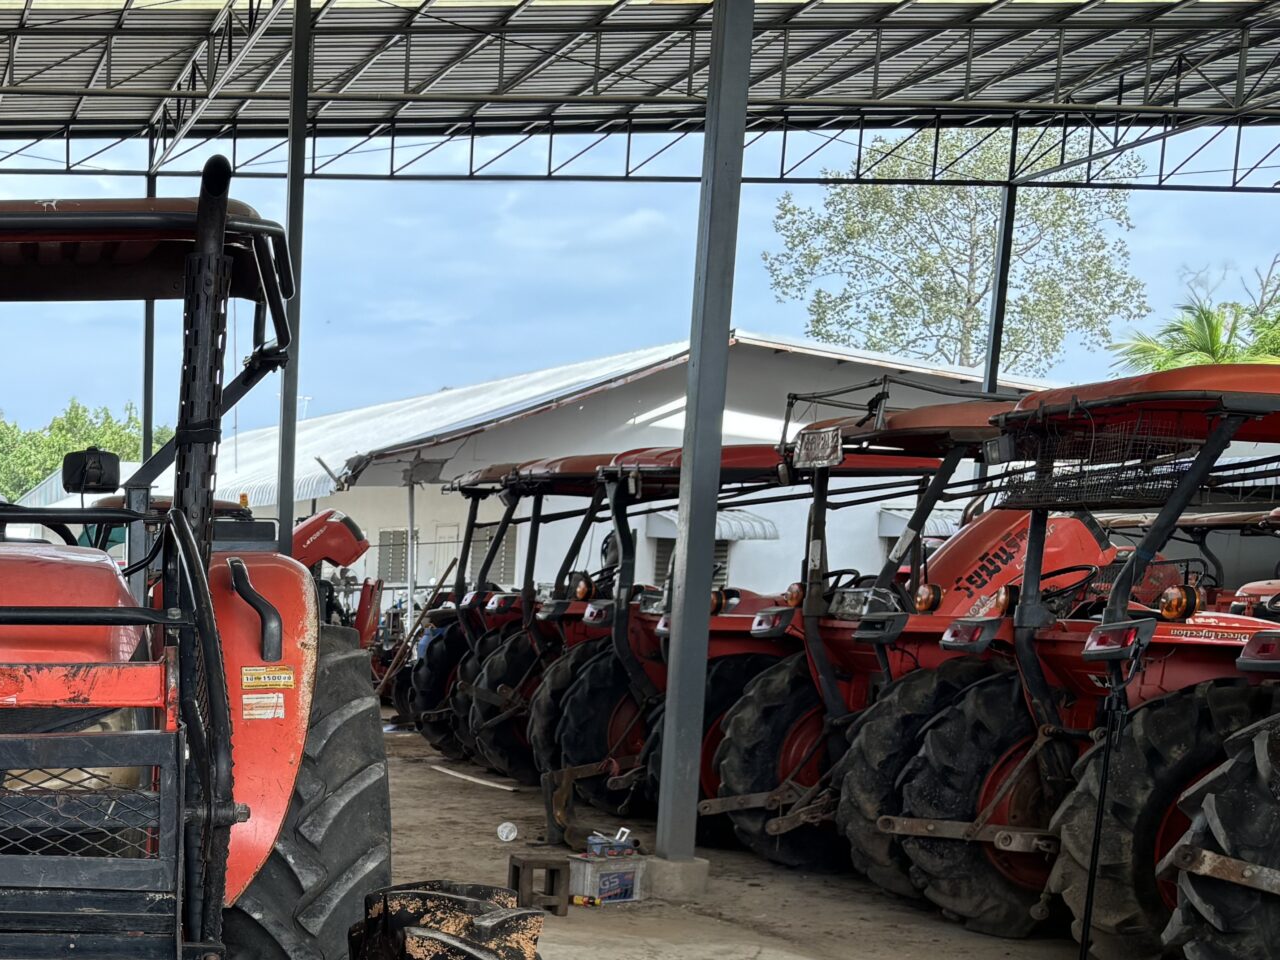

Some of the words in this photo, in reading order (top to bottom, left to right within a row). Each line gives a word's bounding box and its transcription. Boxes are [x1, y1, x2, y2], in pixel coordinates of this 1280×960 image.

[1170, 629, 1216, 640] Injection
[1218, 633, 1250, 642] Direct
[600, 874, 620, 889] GS
